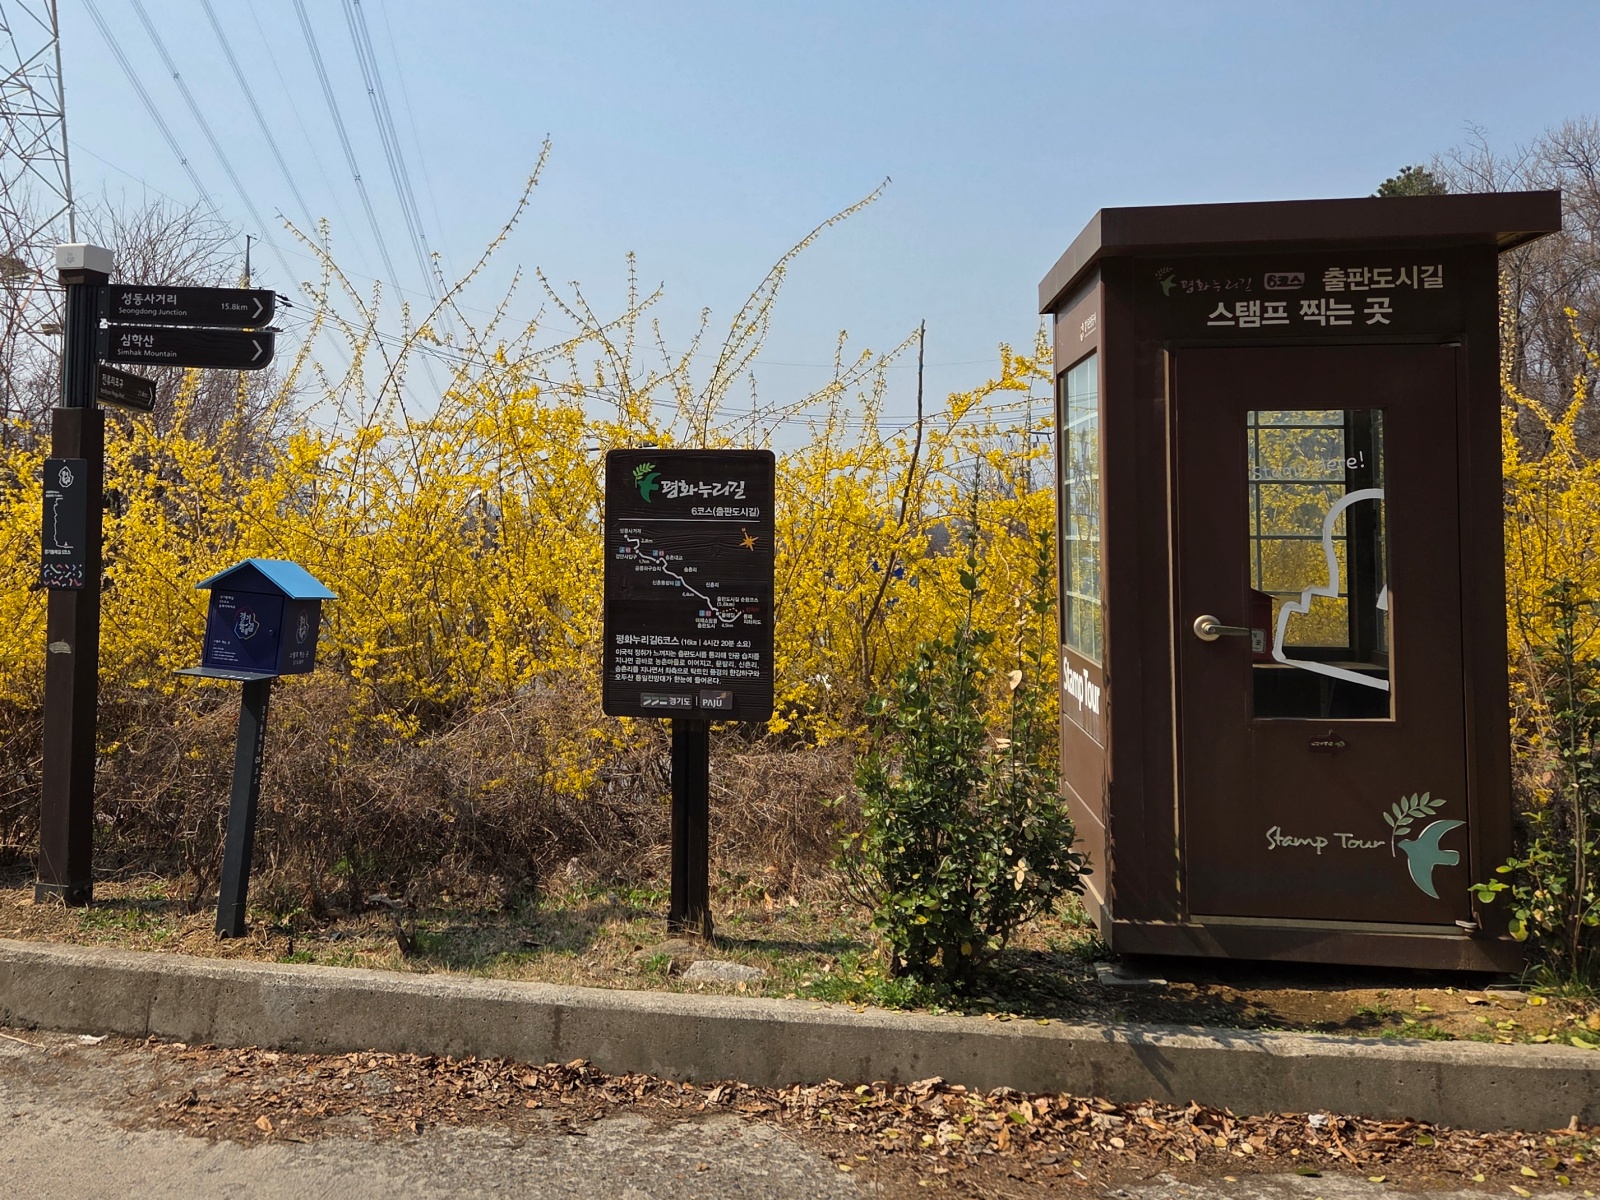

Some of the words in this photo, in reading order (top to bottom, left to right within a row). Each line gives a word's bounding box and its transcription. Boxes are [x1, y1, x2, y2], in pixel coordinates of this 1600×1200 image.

[1265, 274, 1303, 288] 6코스
[1322, 265, 1443, 292] 출판도시길
[121, 292, 177, 305] 성동사거리
[118, 307, 157, 316] Seongdong
[158, 309, 187, 317] Junction
[221, 302, 248, 311] 15.8km
[1207, 300, 1290, 328] 스탬프
[1300, 298, 1355, 326] 찍는
[1363, 297, 1393, 325] 곳
[120, 334, 154, 348] 심학산
[117, 348, 141, 357] Simhak
[143, 350, 177, 358] Mountain
[661, 479, 746, 499] 평화누리길
[691, 506, 760, 517] 6코스(출판도시길)
[615, 634, 680, 645] 평화누리길6코스
[703, 639, 719, 647] 4시간
[736, 640, 751, 648] 소요)
[615, 648, 633, 656] 이국적
[678, 650, 707, 658] 출판도시를
[655, 658, 686, 666] 농촌마을로
[687, 659, 714, 667] 이어지고,
[738, 661, 760, 669] 신촌리,
[615, 665, 639, 673] 송촌리를
[640, 666, 664, 674] 지나면서
[729, 669, 760, 677] 한강하구와
[635, 674, 672, 683] 통일전망대가
[1063, 656, 1084, 711] Stamp
[1083, 668, 1101, 715] Tour
[669, 697, 690, 706] 경기도
[702, 698, 722, 708] PAJU
[1266, 826, 1328, 855] Stamp
[1333, 832, 1386, 849] Tour
